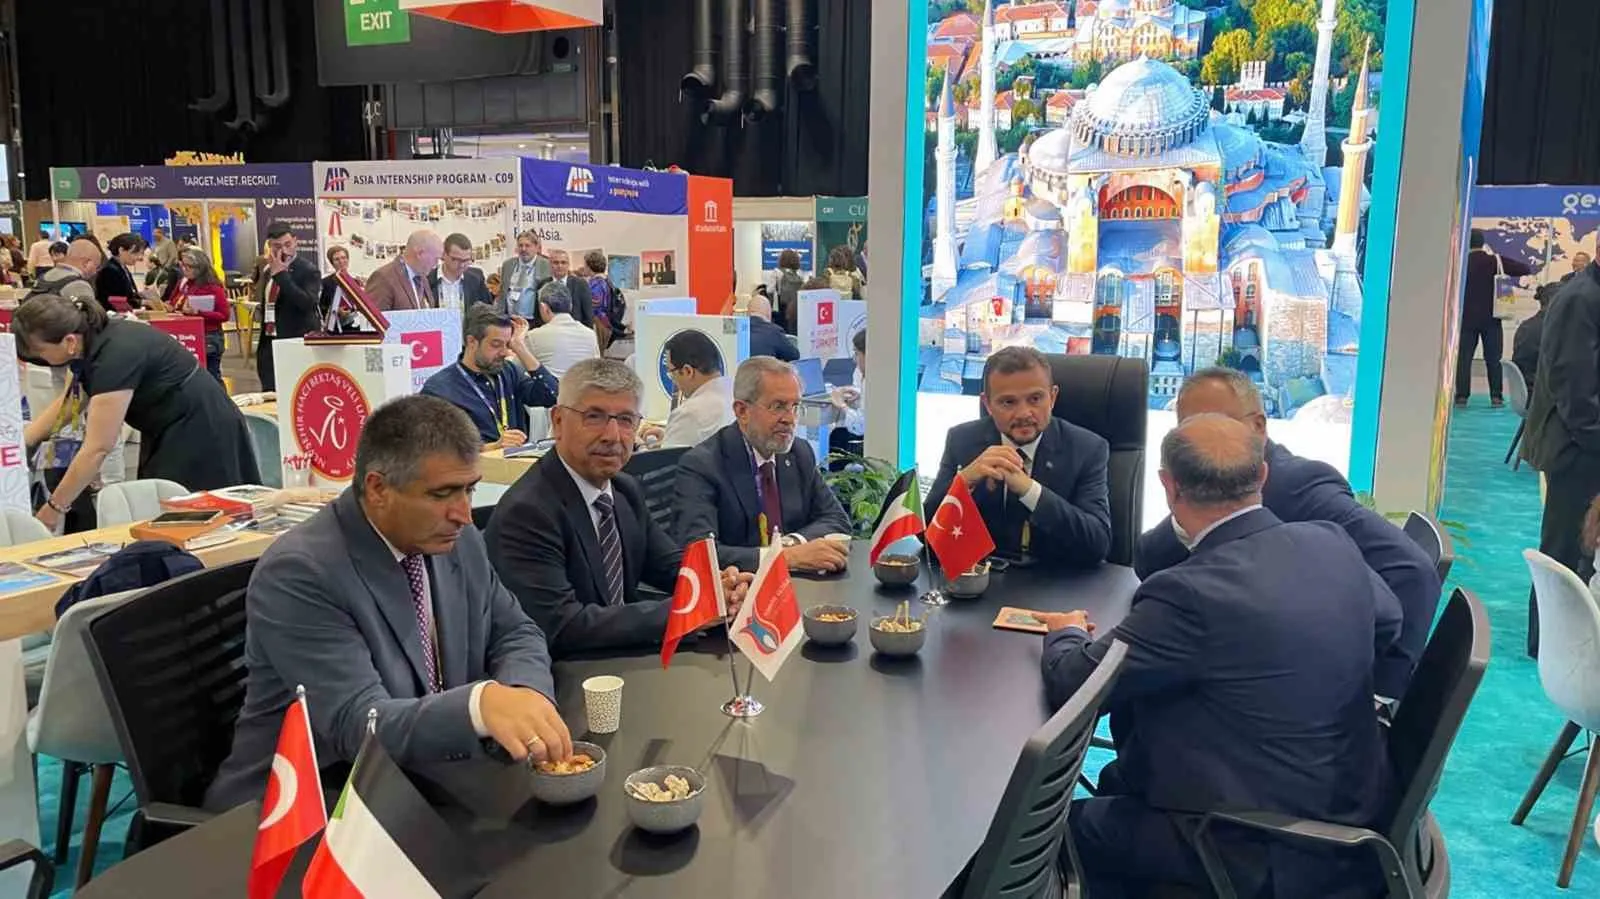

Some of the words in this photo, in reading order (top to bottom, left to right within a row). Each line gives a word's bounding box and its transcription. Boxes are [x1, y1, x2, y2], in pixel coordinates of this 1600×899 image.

[360, 10, 392, 31] EXIT
[111, 176, 156, 189] SRTFAIRS
[353, 175, 374, 185] ASIA
[376, 174, 433, 185] INTERNSHIP
[436, 174, 486, 184] PROGRAM
[495, 172, 514, 184] C09
[537, 209, 597, 225] Internships.
[539, 228, 562, 241] Asia.
